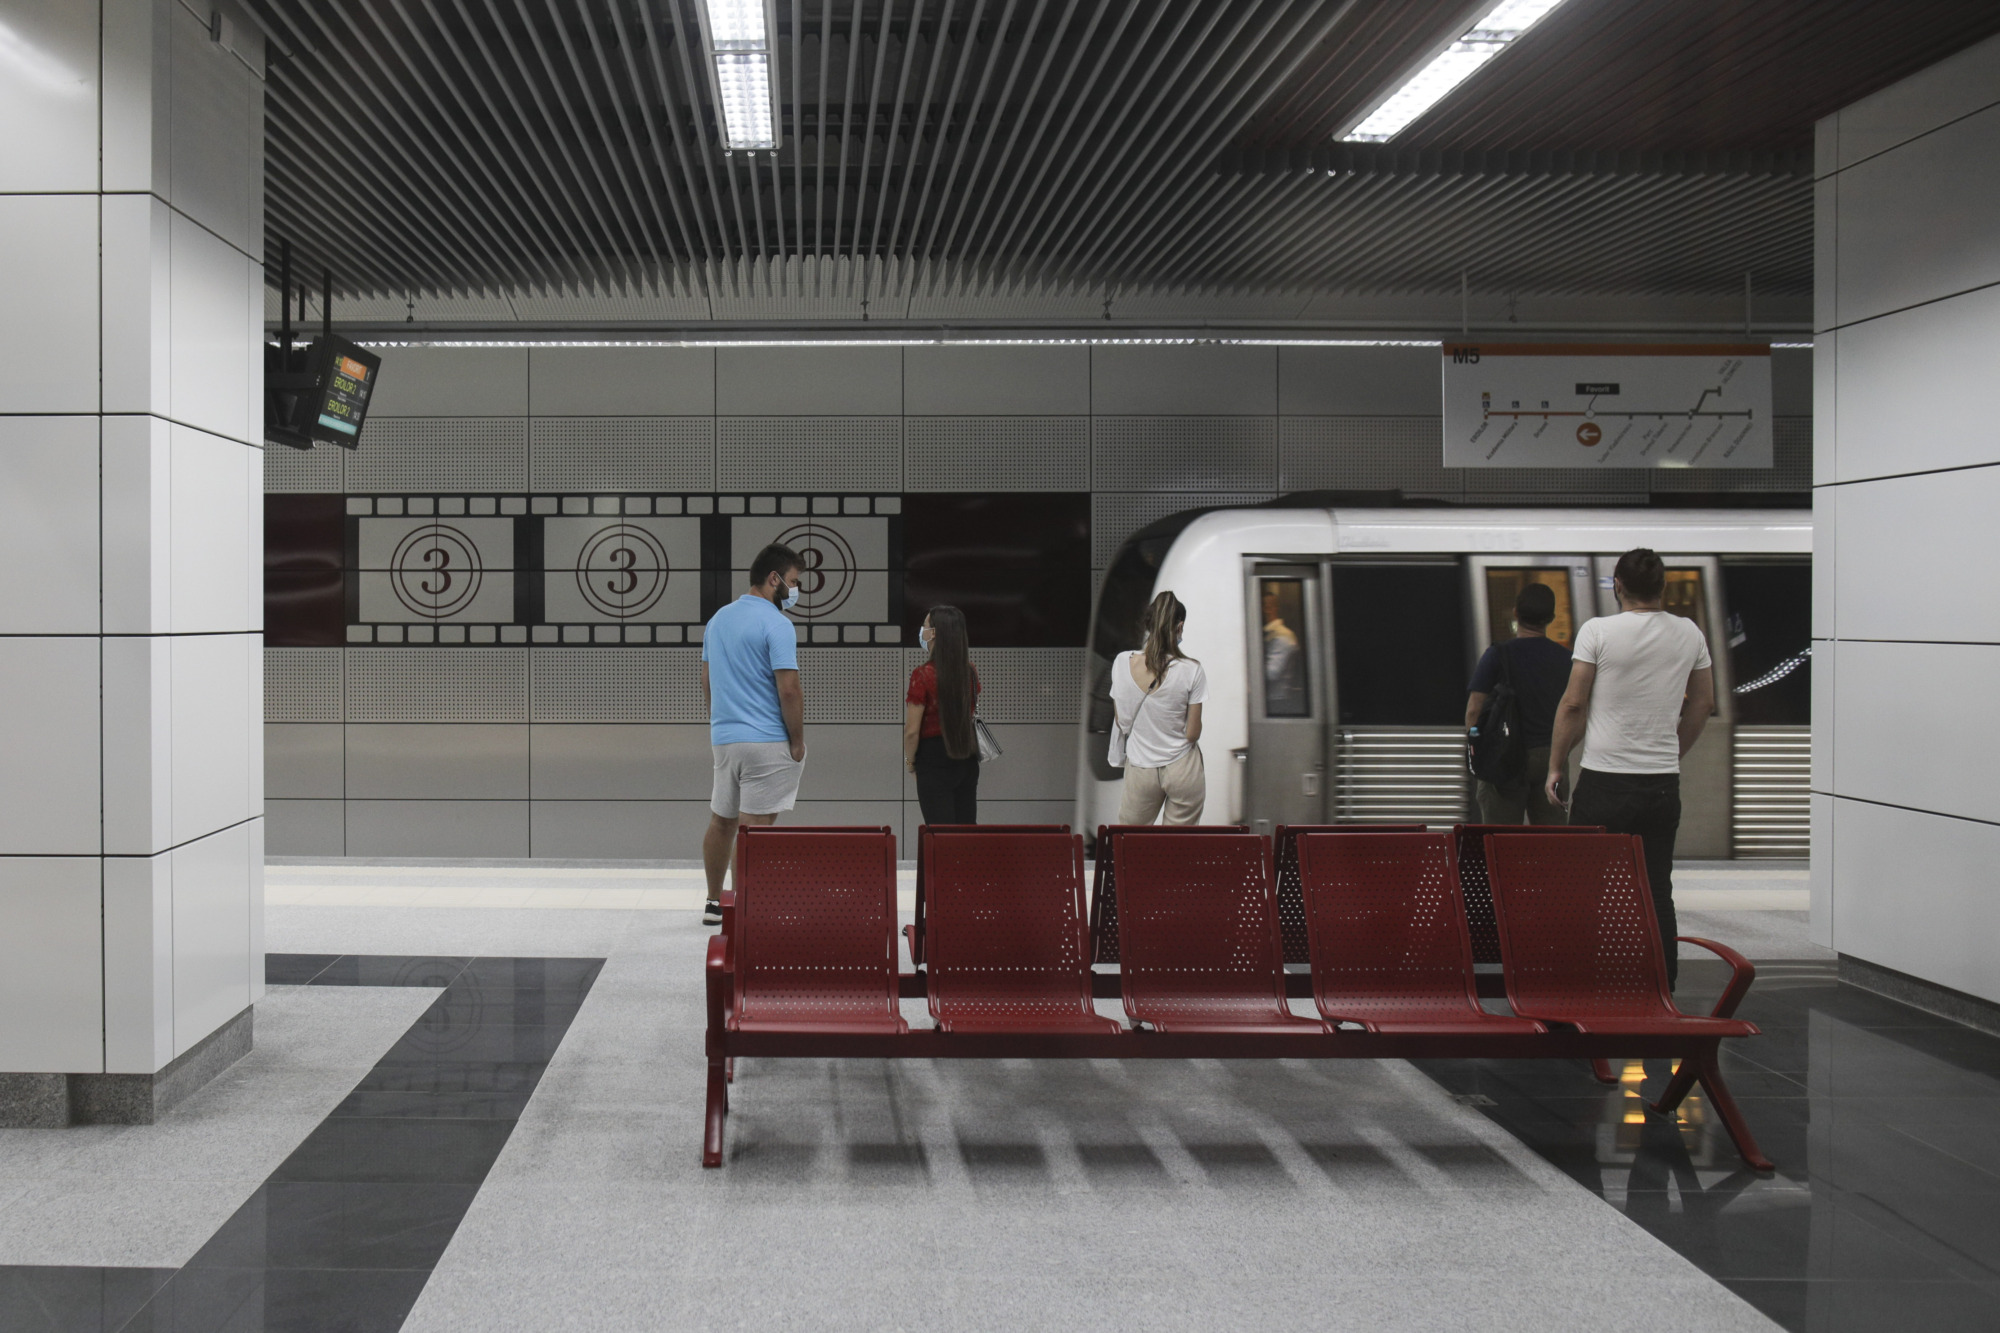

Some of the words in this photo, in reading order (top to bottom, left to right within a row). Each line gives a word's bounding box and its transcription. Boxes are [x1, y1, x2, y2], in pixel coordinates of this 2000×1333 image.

[1453, 347, 1480, 364] M5
[1585, 385, 1610, 393] Favorit
[421, 548, 451, 595] 3
[607, 548, 638, 595] 3
